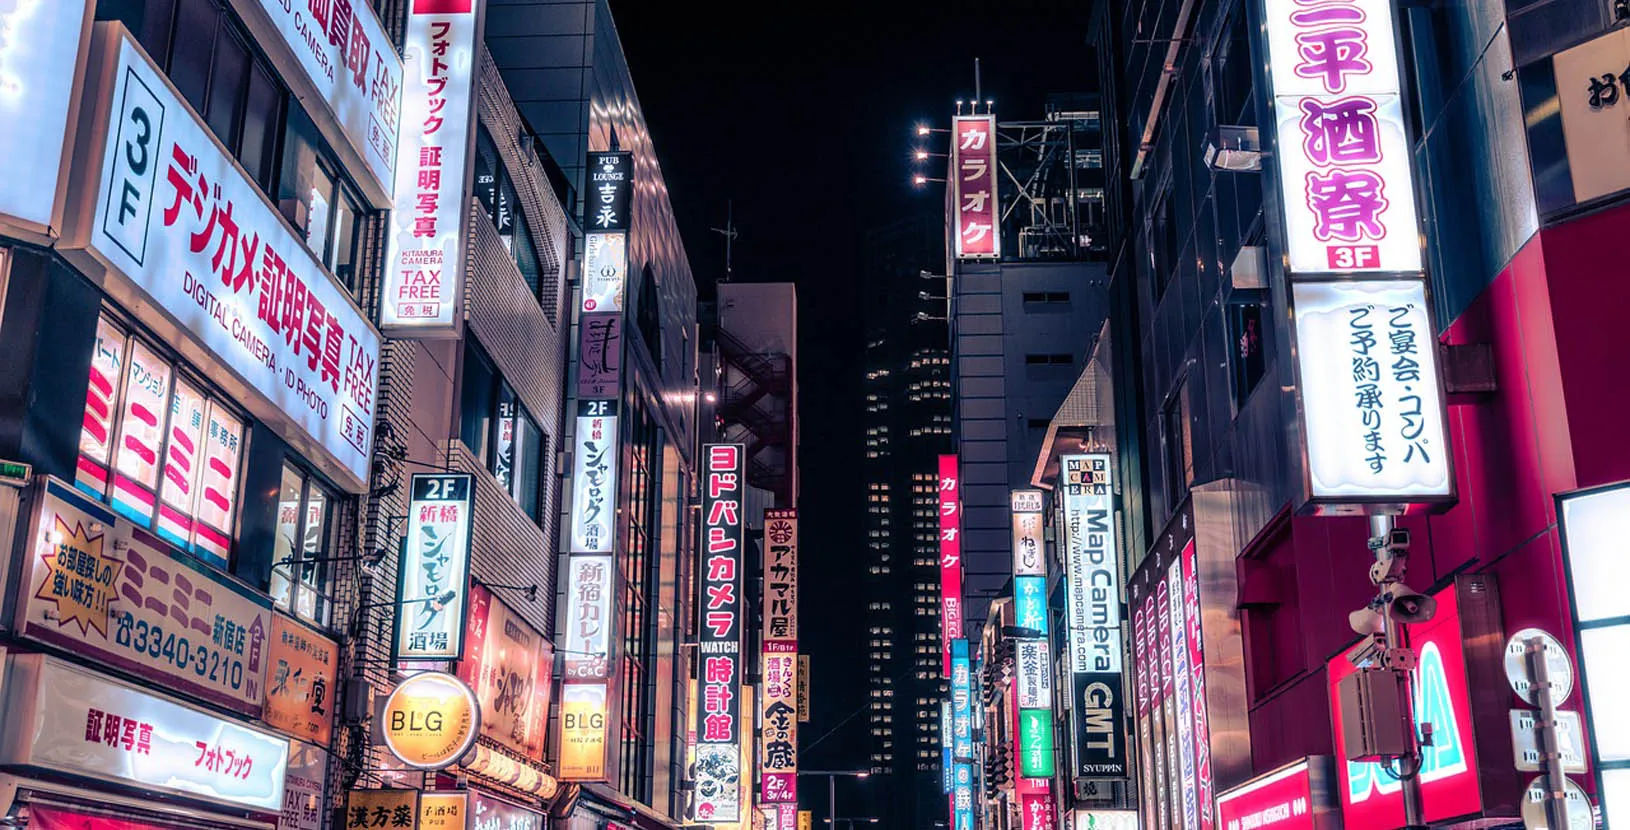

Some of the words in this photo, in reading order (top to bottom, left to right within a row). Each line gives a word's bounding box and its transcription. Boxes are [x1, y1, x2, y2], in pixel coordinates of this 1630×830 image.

[294, 12, 334, 83] CAMERA
[375, 50, 398, 102] TAX
[424, 22, 451, 135] フォトブック
[1587, 62, 1630, 110] お
[371, 79, 396, 135] FREE
[592, 172, 624, 181] LOUNGE
[599, 156, 620, 165] PUB
[413, 146, 442, 238] 証明写真
[596, 183, 618, 228] 吉永
[959, 128, 992, 245] カラオケ
[401, 257, 443, 265] CAMERA
[401, 270, 441, 285] TAX
[1335, 247, 1372, 268] 3F
[399, 286, 440, 299] FREE
[404, 305, 433, 316] 免税
[183, 271, 228, 330] DIGITAL
[232, 318, 276, 374] CAMERA
[284, 367, 295, 389] ID
[296, 379, 328, 420] PHOTO
[348, 334, 374, 388] TAX
[132, 362, 166, 399] マンション
[343, 366, 372, 416] FREE
[1349, 304, 1387, 475] ご予約承ります
[1388, 303, 1430, 464] ご宴会・コンパ
[587, 401, 608, 415] 2F
[583, 441, 609, 524] シャモロック
[1069, 460, 1105, 470] MAP
[1070, 472, 1105, 482] CAM
[425, 479, 455, 499] 2F
[1070, 485, 1106, 495] ERA
[419, 505, 458, 522] 新橋
[940, 477, 959, 568] カラオケ
[1084, 509, 1109, 564] Map
[706, 446, 738, 637] ヨドバシカメラ
[57, 543, 113, 587] お部屋探しの
[417, 525, 452, 630] シャモロク
[121, 548, 213, 636] ミニミニ
[578, 562, 603, 658] 新宿カレー
[769, 545, 791, 637] アカマル屋
[944, 597, 957, 620] BIG
[1070, 509, 1087, 671] http://www.mapcamera.com
[1157, 579, 1170, 631] CLUB
[212, 613, 246, 657] 新宿店
[408, 632, 448, 650] 酒場
[1091, 569, 1112, 671] Camera
[1134, 609, 1146, 657] CLUB
[1145, 595, 1157, 646] CLUB
[133, 619, 243, 690] 3340-3210
[700, 641, 738, 653] WATCH
[245, 678, 258, 701] IN
[567, 667, 576, 675] by
[577, 666, 604, 677] C&C
[782, 656, 793, 697] きんくら
[391, 710, 443, 732] BLG
[565, 713, 603, 729] BLG
[703, 656, 734, 742] 時計館
[1083, 682, 1115, 758] GMT
[85, 707, 154, 755] 証明写真
[194, 740, 253, 780] フォトブック
[764, 700, 797, 769] 金の蔵
[766, 775, 787, 791] 2F/
[1083, 763, 1122, 773] SYUPPIN
[285, 789, 301, 810] TAX
[348, 804, 412, 829] 漢方薬
[767, 791, 793, 800] 3F/4F
